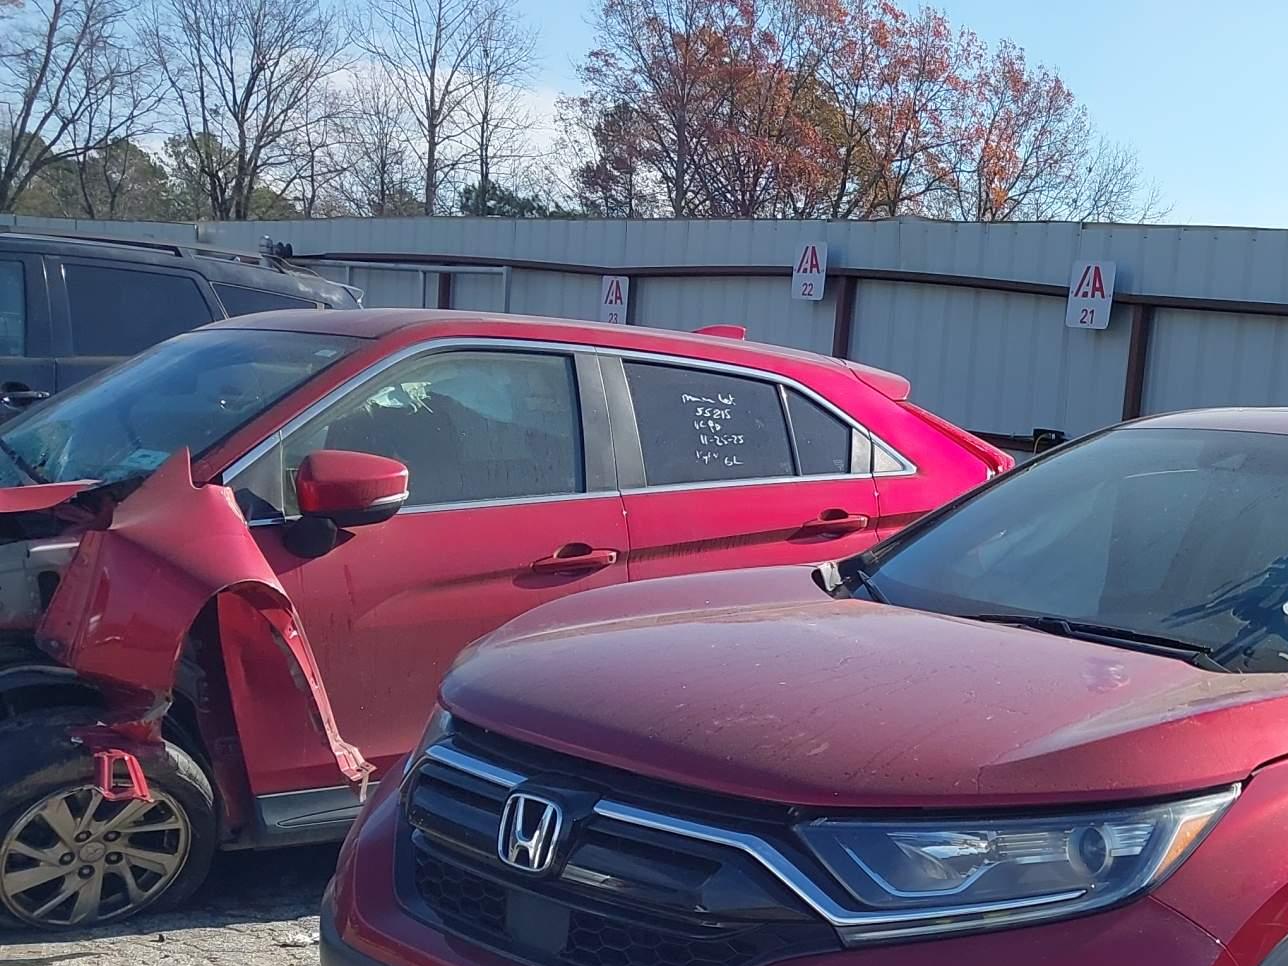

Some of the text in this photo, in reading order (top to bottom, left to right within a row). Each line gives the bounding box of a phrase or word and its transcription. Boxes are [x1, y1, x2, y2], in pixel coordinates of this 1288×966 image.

[802, 282, 814, 296] 22
[608, 312, 619, 325] 23
[1079, 308, 1095, 325] 21
